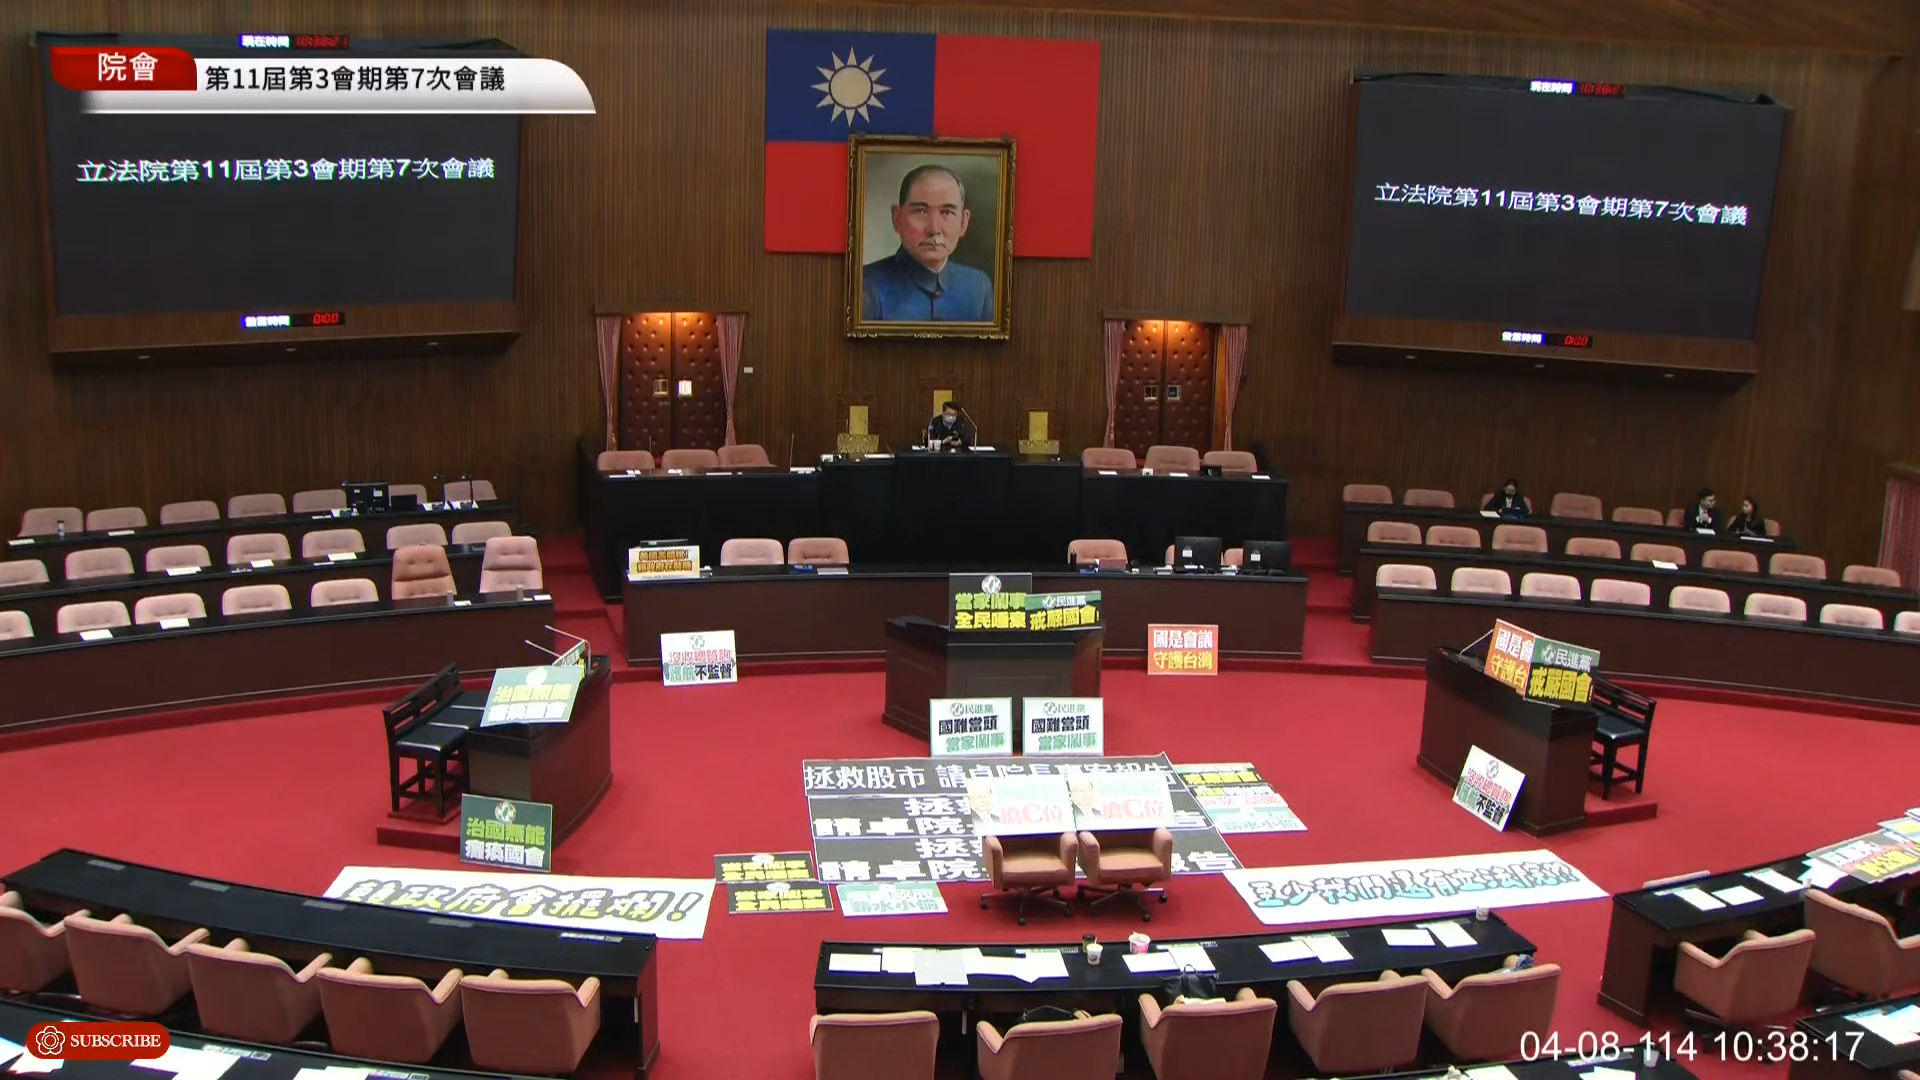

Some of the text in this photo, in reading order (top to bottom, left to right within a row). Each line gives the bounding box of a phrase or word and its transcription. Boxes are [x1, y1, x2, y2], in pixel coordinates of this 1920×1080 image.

[76, 157, 495, 184] 立法院第11屆第3會期第7次會議
[1374, 182, 1749, 227] 立法院第11屆第3會期第7次會議
[955, 592, 1026, 610] 當家鬧事
[1056, 595, 1087, 607] 民進黨
[1153, 629, 1213, 648] 國是會議
[1153, 651, 1213, 670] 守護台灣
[1555, 648, 1592, 673] 民進黨
[965, 703, 994, 714] 民進黨
[1057, 703, 1086, 714] 民進黨
[939, 715, 999, 735] 國難當頭
[1031, 715, 1090, 734] 國難當頭
[945, 732, 1005, 752] 當家鬧事
[1038, 732, 1097, 752] 當家鬧事
[805, 765, 926, 790] 拯救股市
[466, 816, 546, 846] 治國無能
